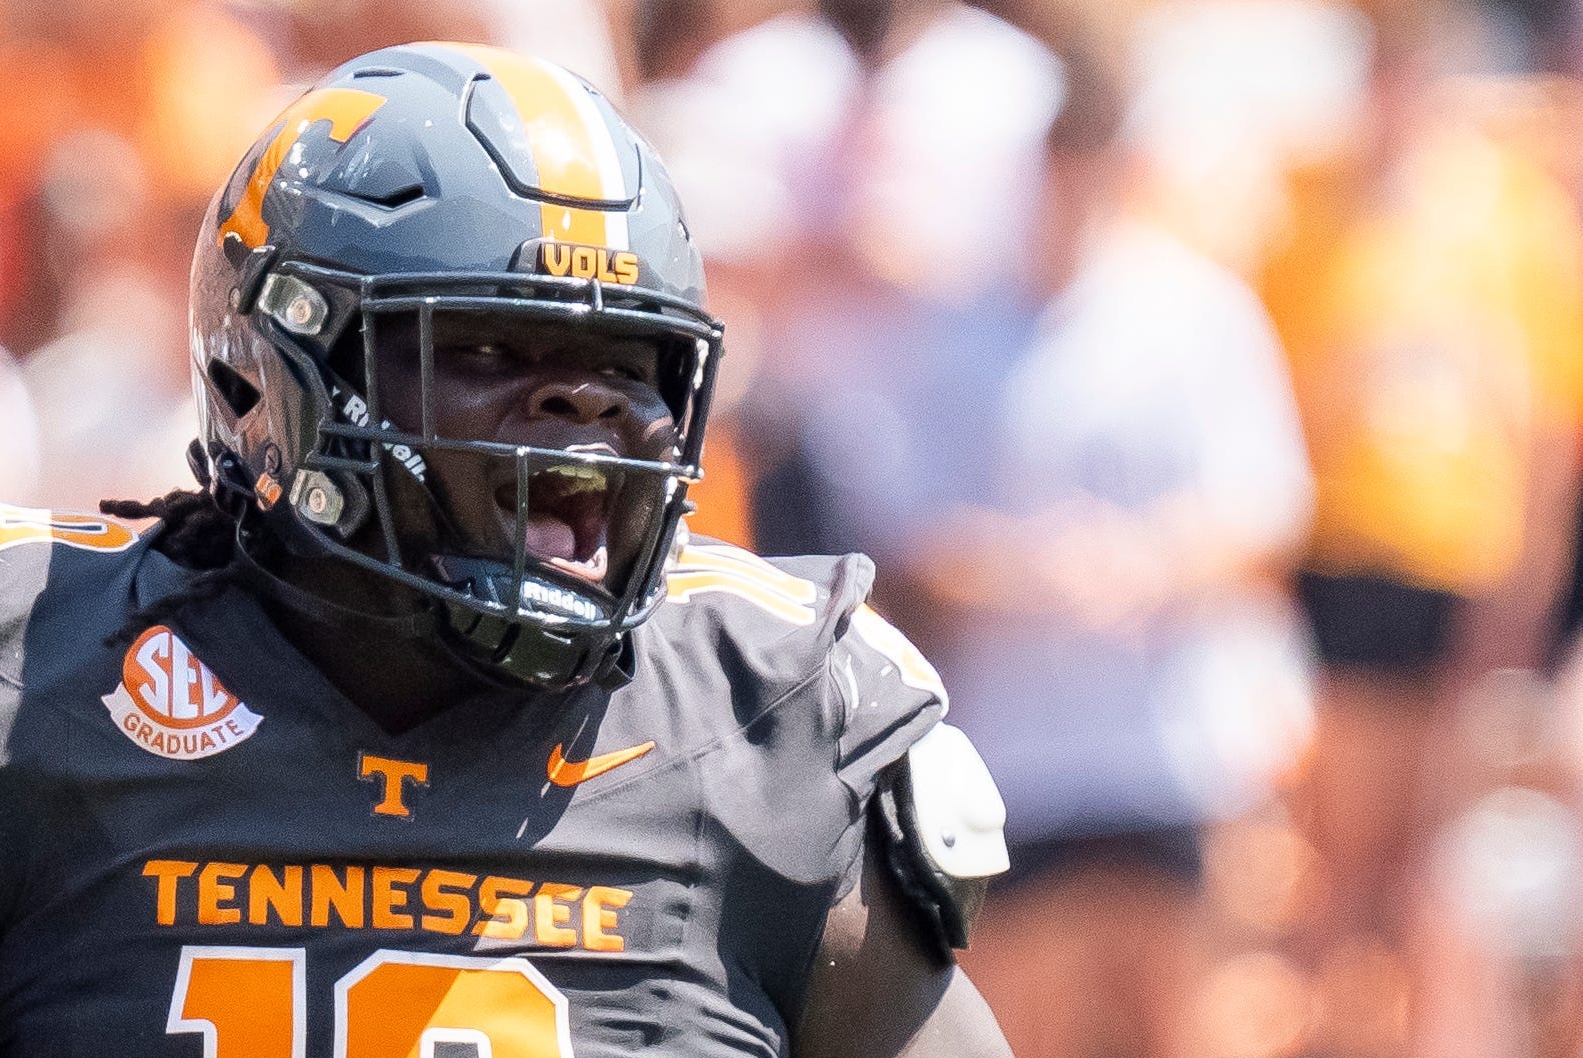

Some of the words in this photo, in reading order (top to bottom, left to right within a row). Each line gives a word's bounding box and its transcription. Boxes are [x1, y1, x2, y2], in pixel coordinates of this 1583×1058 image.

[544, 243, 639, 285] VOLS
[343, 394, 427, 478] Riell
[123, 712, 245, 755] GRADUATE
[357, 750, 430, 821] T
[142, 859, 634, 952] TENNESSEE
